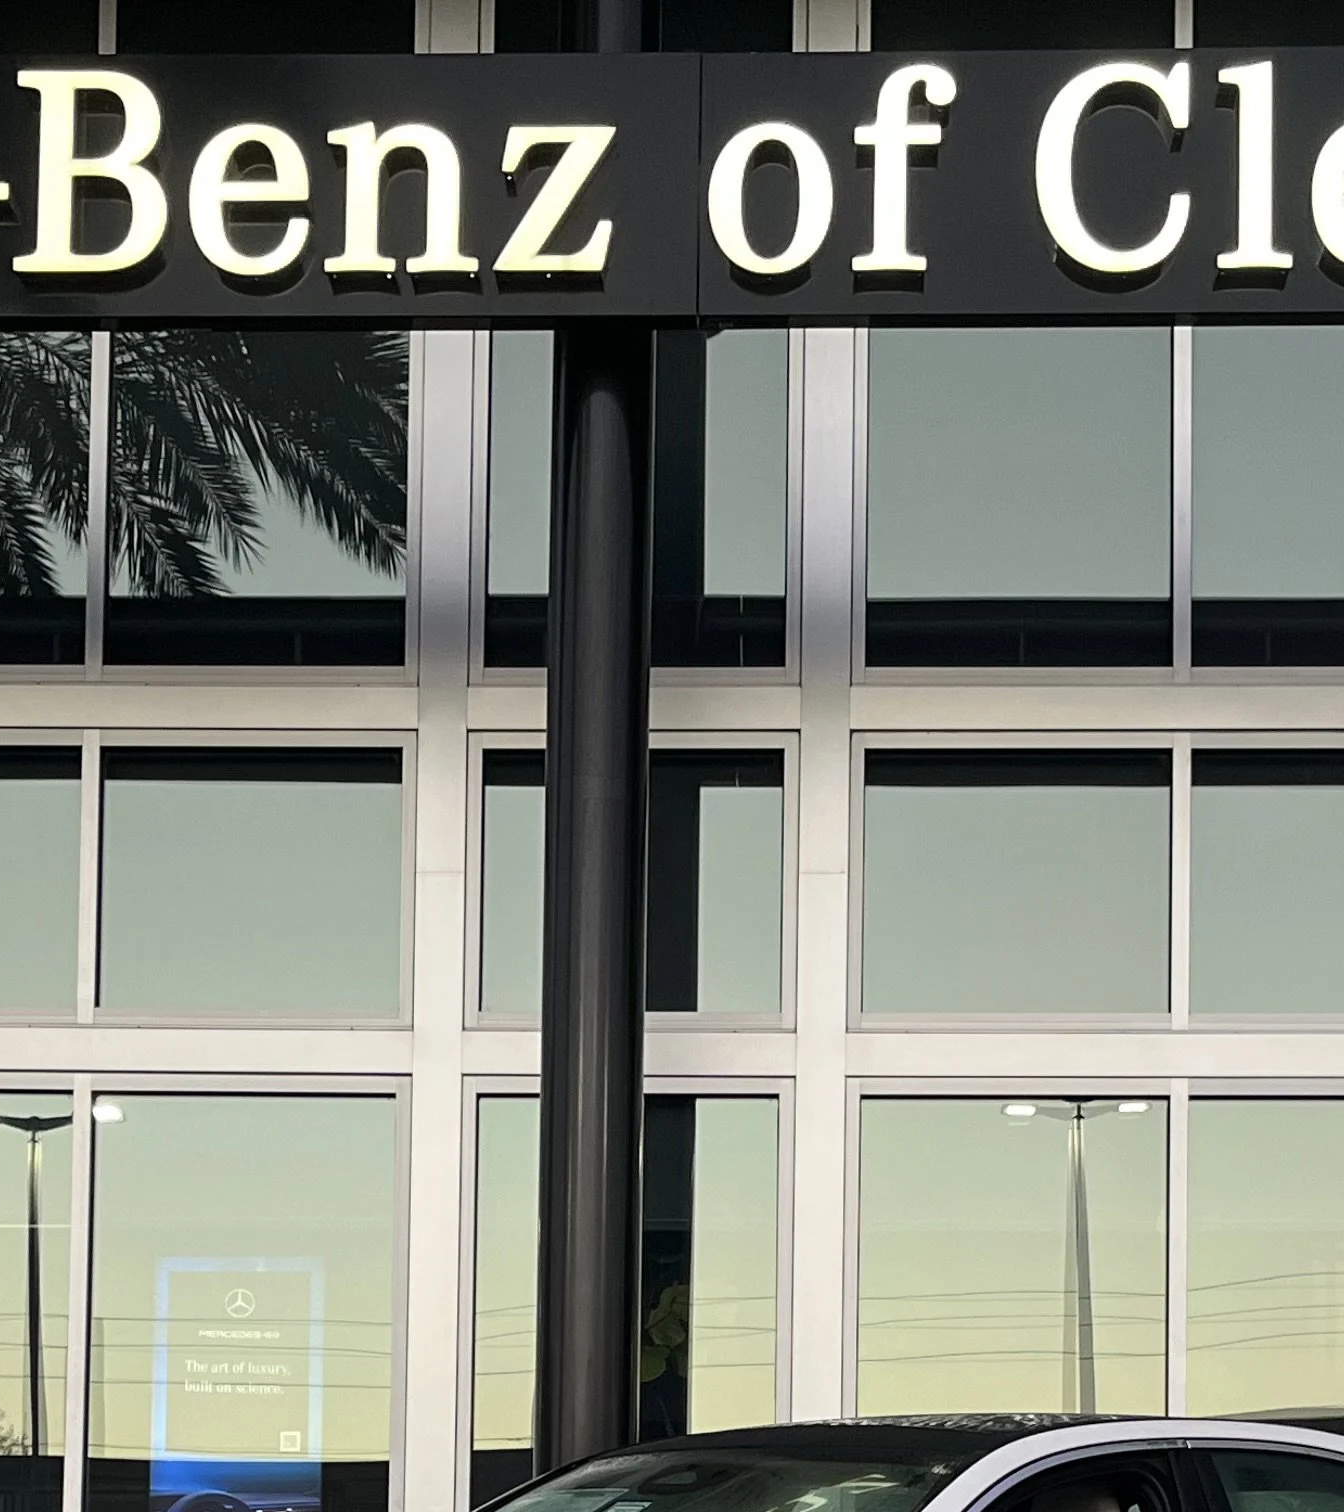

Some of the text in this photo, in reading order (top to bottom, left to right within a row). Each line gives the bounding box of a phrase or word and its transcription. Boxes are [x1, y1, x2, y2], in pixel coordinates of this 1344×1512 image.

[707, 64, 958, 276] of
[185, 1360, 208, 1373] The
[211, 1362, 229, 1374] art
[232, 1360, 246, 1374] of
[184, 1379, 213, 1393] built
[216, 1383, 232, 1393] on
